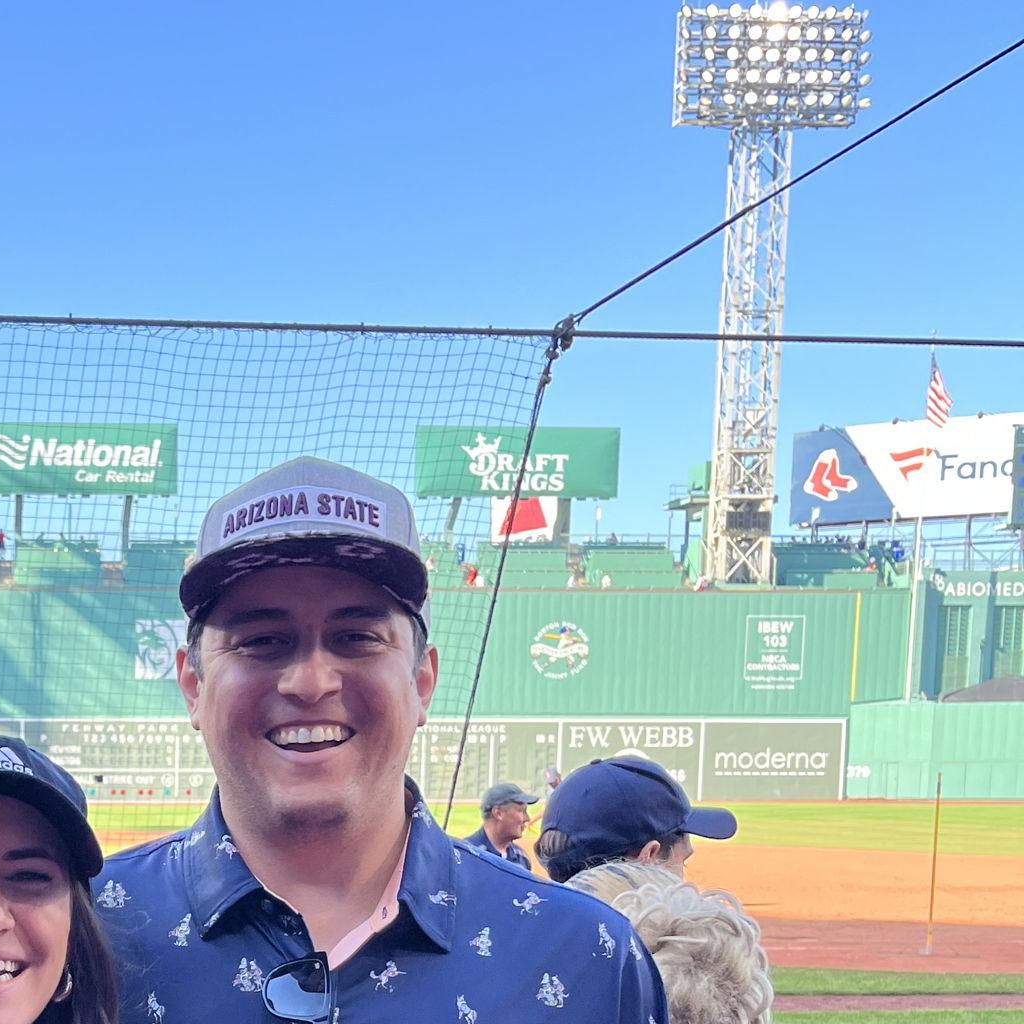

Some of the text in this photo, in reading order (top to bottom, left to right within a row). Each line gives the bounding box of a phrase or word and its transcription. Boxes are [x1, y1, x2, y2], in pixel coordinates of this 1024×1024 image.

[29, 438, 163, 468] National
[469, 451, 569, 477] DRAFT
[75, 470, 156, 483] Car Rental
[222, 491, 381, 539] ARIZONA STATE
[757, 620, 795, 634] IBEW
[763, 634, 788, 648] 103
[62, 724, 127, 733] FENWAY
[417, 724, 461, 733] ATIONAL
[618, 725, 695, 748] WEBB
[714, 747, 827, 770] moderna
